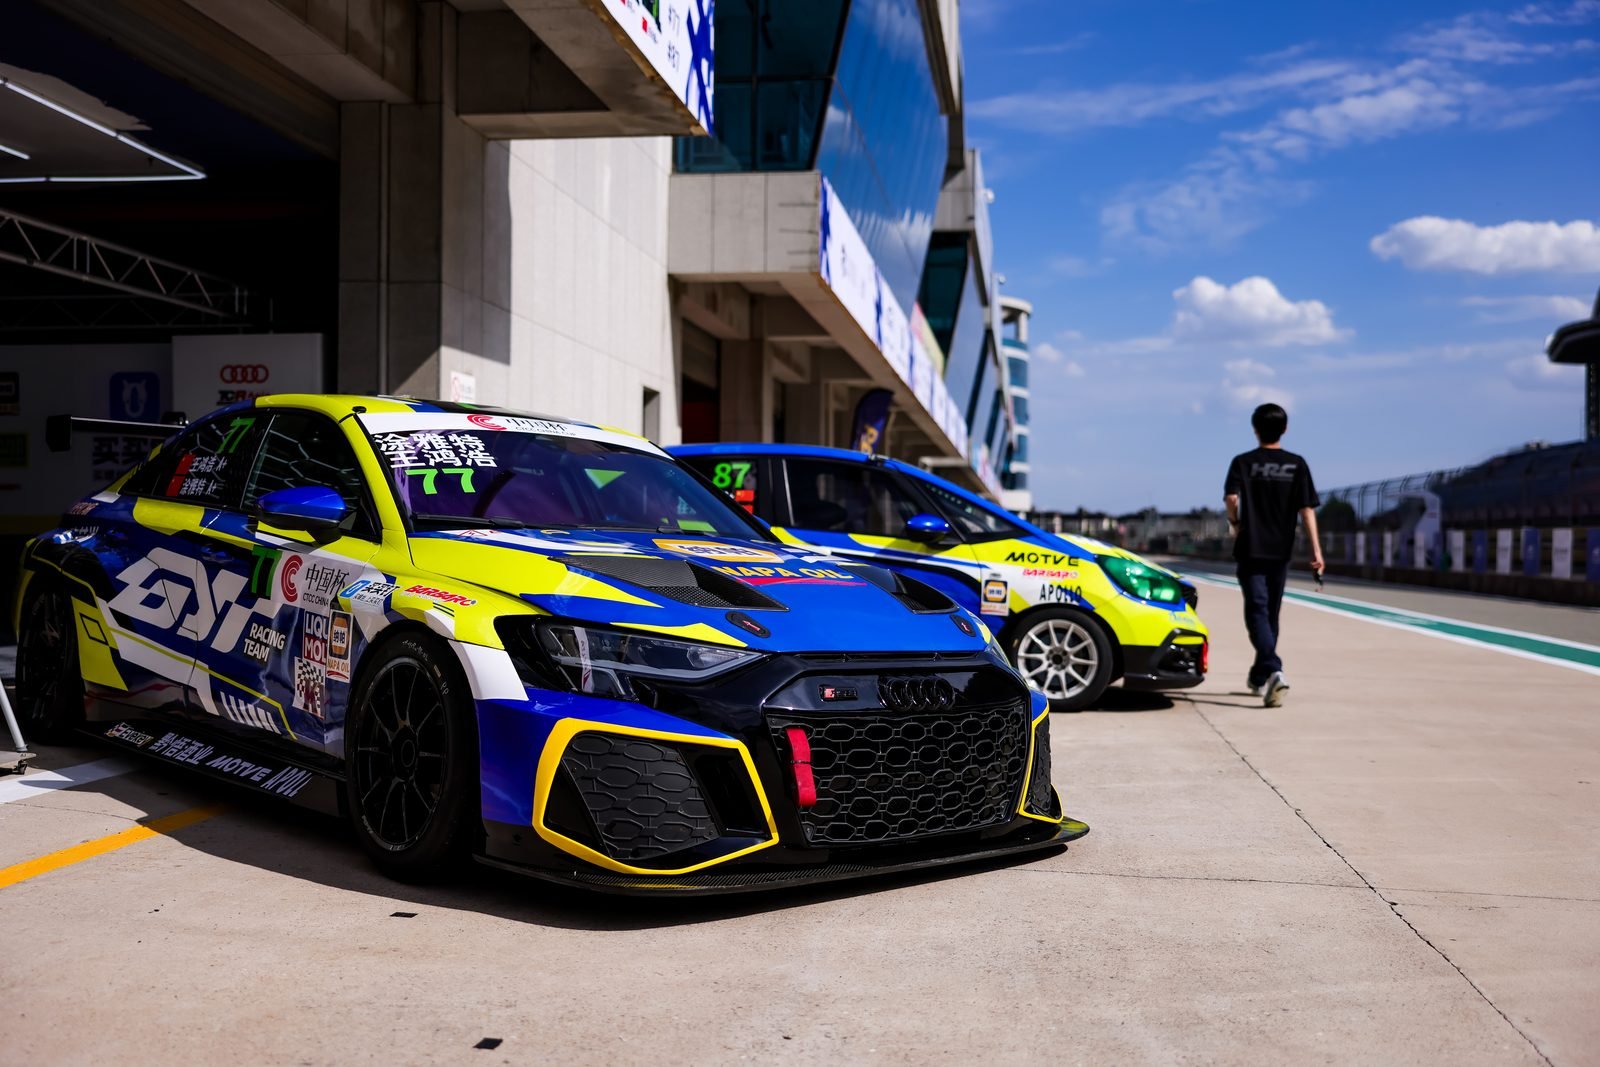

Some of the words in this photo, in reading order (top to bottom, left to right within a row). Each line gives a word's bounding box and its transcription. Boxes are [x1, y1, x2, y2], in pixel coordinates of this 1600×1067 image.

[217, 418, 257, 453] 77
[374, 433, 485, 451] 涂雅特
[384, 449, 498, 468] 王鸿浩
[1250, 463, 1297, 477] HRC
[404, 468, 476, 495] 77
[712, 462, 752, 489] 87
[251, 545, 283, 599] 77
[305, 563, 350, 596] 中国杯
[710, 565, 802, 578] NAPA
[799, 567, 855, 579] OIL
[303, 592, 315, 604] CTCC
[1040, 584, 1082, 603] APOLLO
[249, 622, 286, 650] RACING
[305, 613, 329, 640] LIQU
[243, 638, 270, 662] TEAM
[304, 637, 328, 663] MOL
[327, 658, 340, 672] NAPA
[341, 662, 350, 673] OIL
